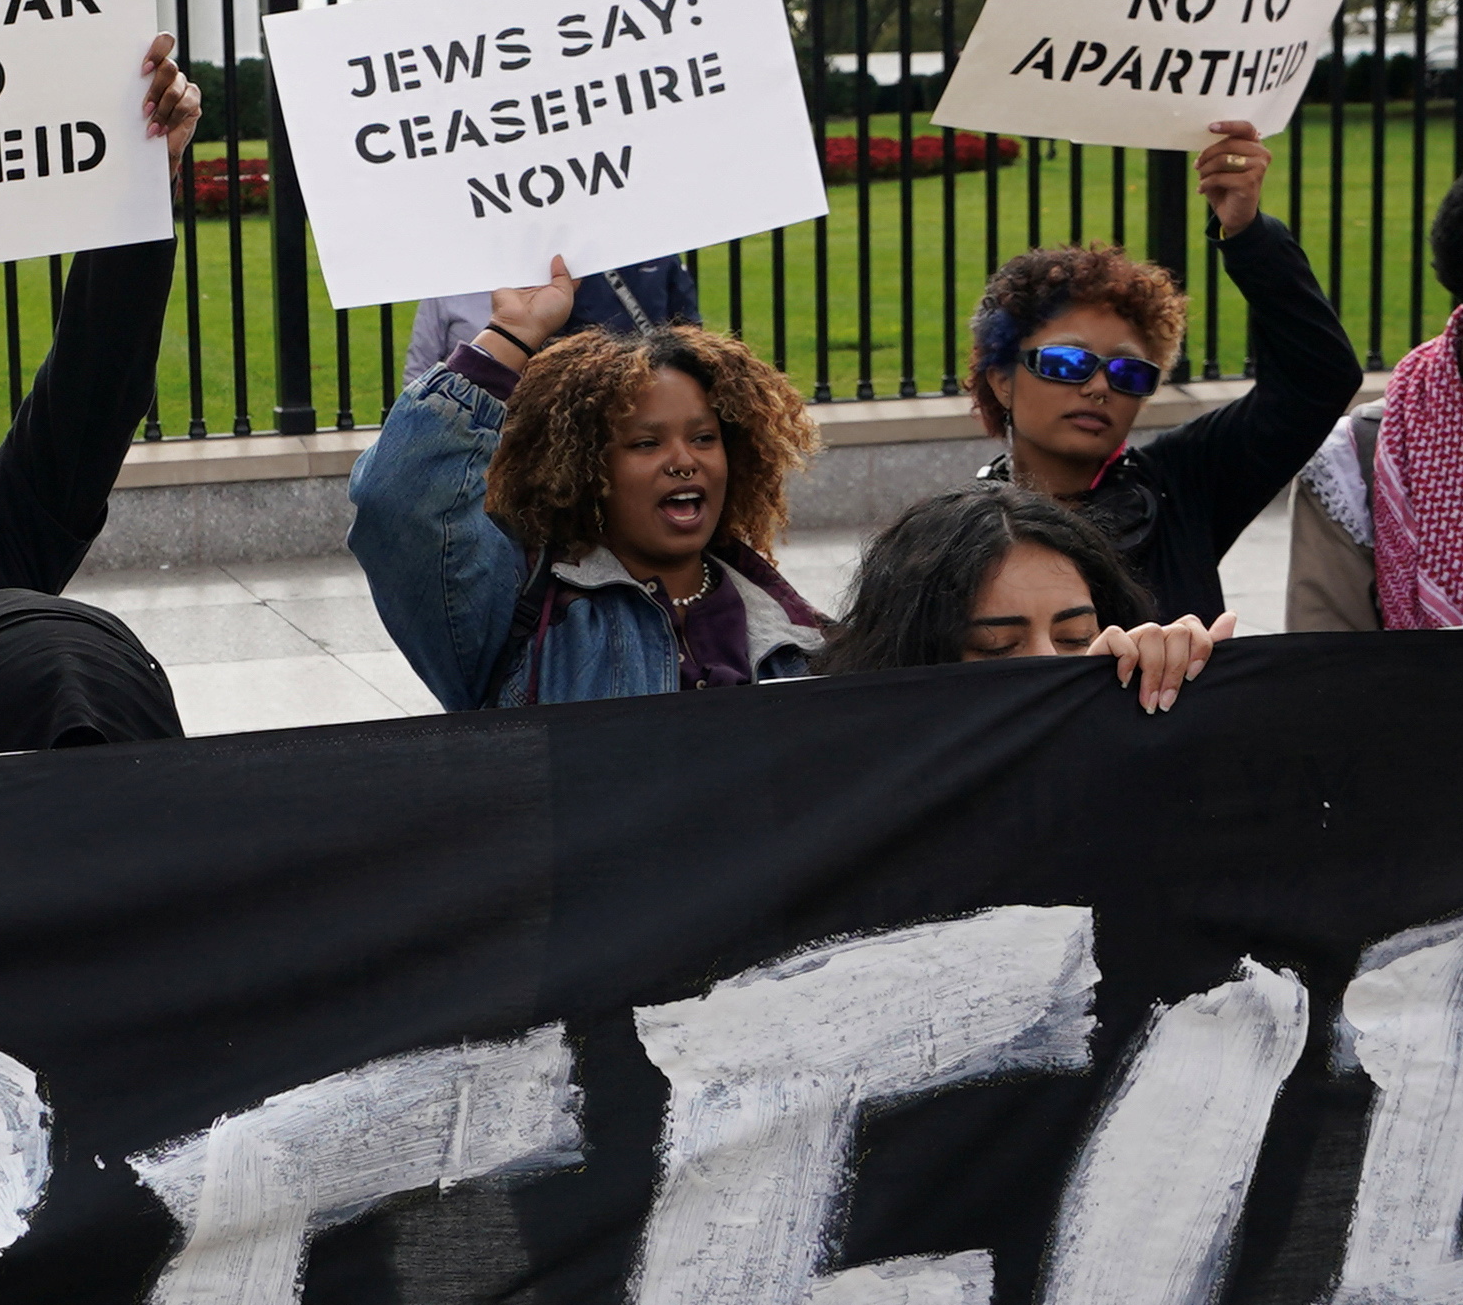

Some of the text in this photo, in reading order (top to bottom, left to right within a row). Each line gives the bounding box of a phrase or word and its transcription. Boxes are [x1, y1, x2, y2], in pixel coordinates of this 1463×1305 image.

[347, 26, 533, 98] JEWS
[1009, 36, 1309, 97] APARTHEID
[354, 51, 726, 165] CEASEFIRE
[466, 144, 633, 219] NOW
